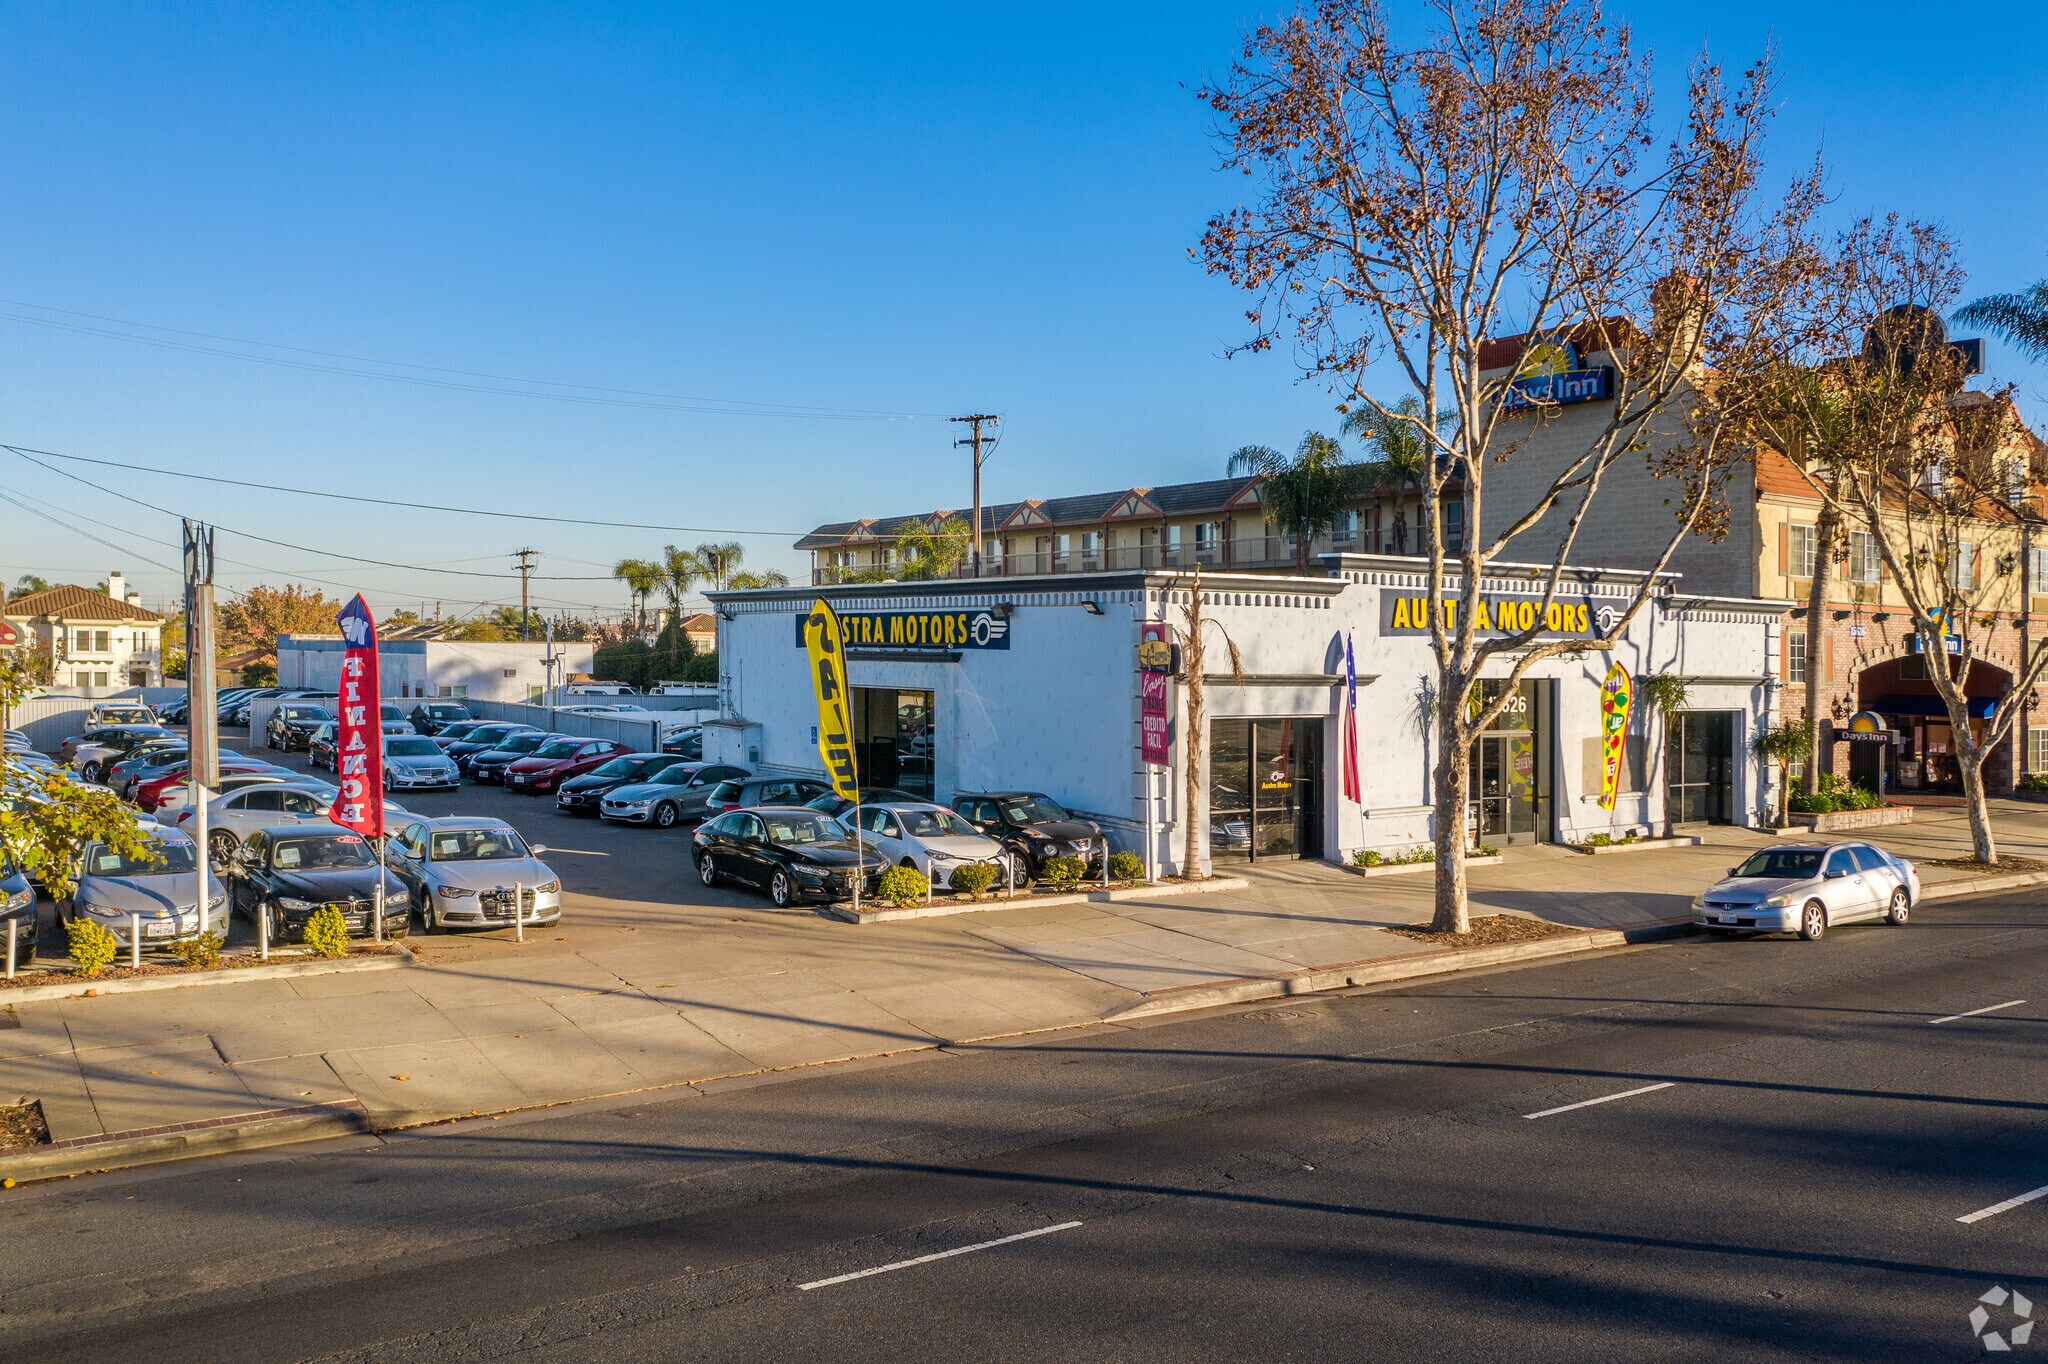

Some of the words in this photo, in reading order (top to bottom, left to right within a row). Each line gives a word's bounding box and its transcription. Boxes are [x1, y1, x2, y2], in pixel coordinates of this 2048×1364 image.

[1557, 376, 1598, 399] Inn
[1391, 597, 1491, 630] AUTA
[842, 615, 885, 645] STRA
[890, 613, 968, 645] MOTORS
[1142, 673, 1166, 699] Easy
[1143, 716, 1166, 733] CREDITO
[1841, 731, 1868, 741] Days
[1869, 733, 1888, 741] Inn
[1147, 732, 1162, 749] FACIL
